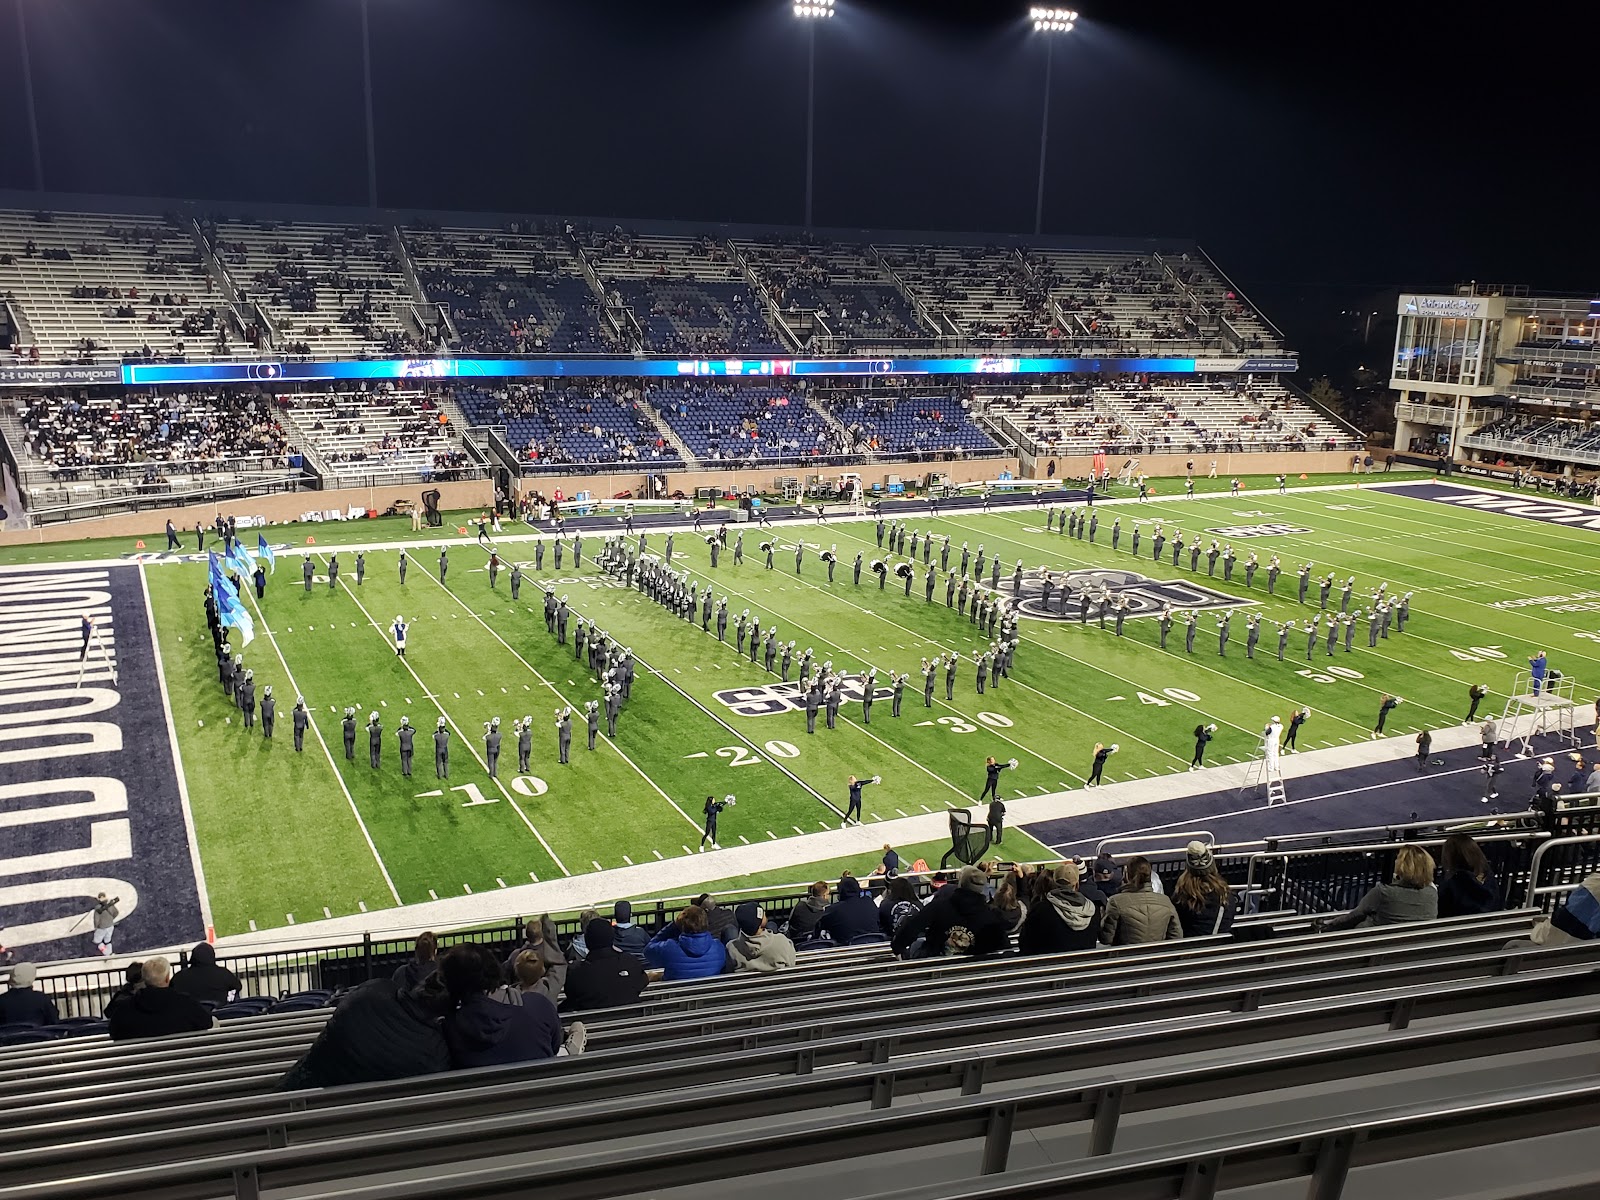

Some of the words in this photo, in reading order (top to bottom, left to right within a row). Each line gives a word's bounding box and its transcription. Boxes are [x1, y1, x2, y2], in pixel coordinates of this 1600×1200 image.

[17, 371, 61, 379] UNDER
[63, 370, 117, 379] ARMOUR
[1448, 645, 1509, 663] 40
[1293, 665, 1365, 684] 50
[1135, 687, 1202, 708] 40
[936, 711, 1015, 734] 30
[714, 740, 801, 767] 20
[449, 774, 550, 808] 10
